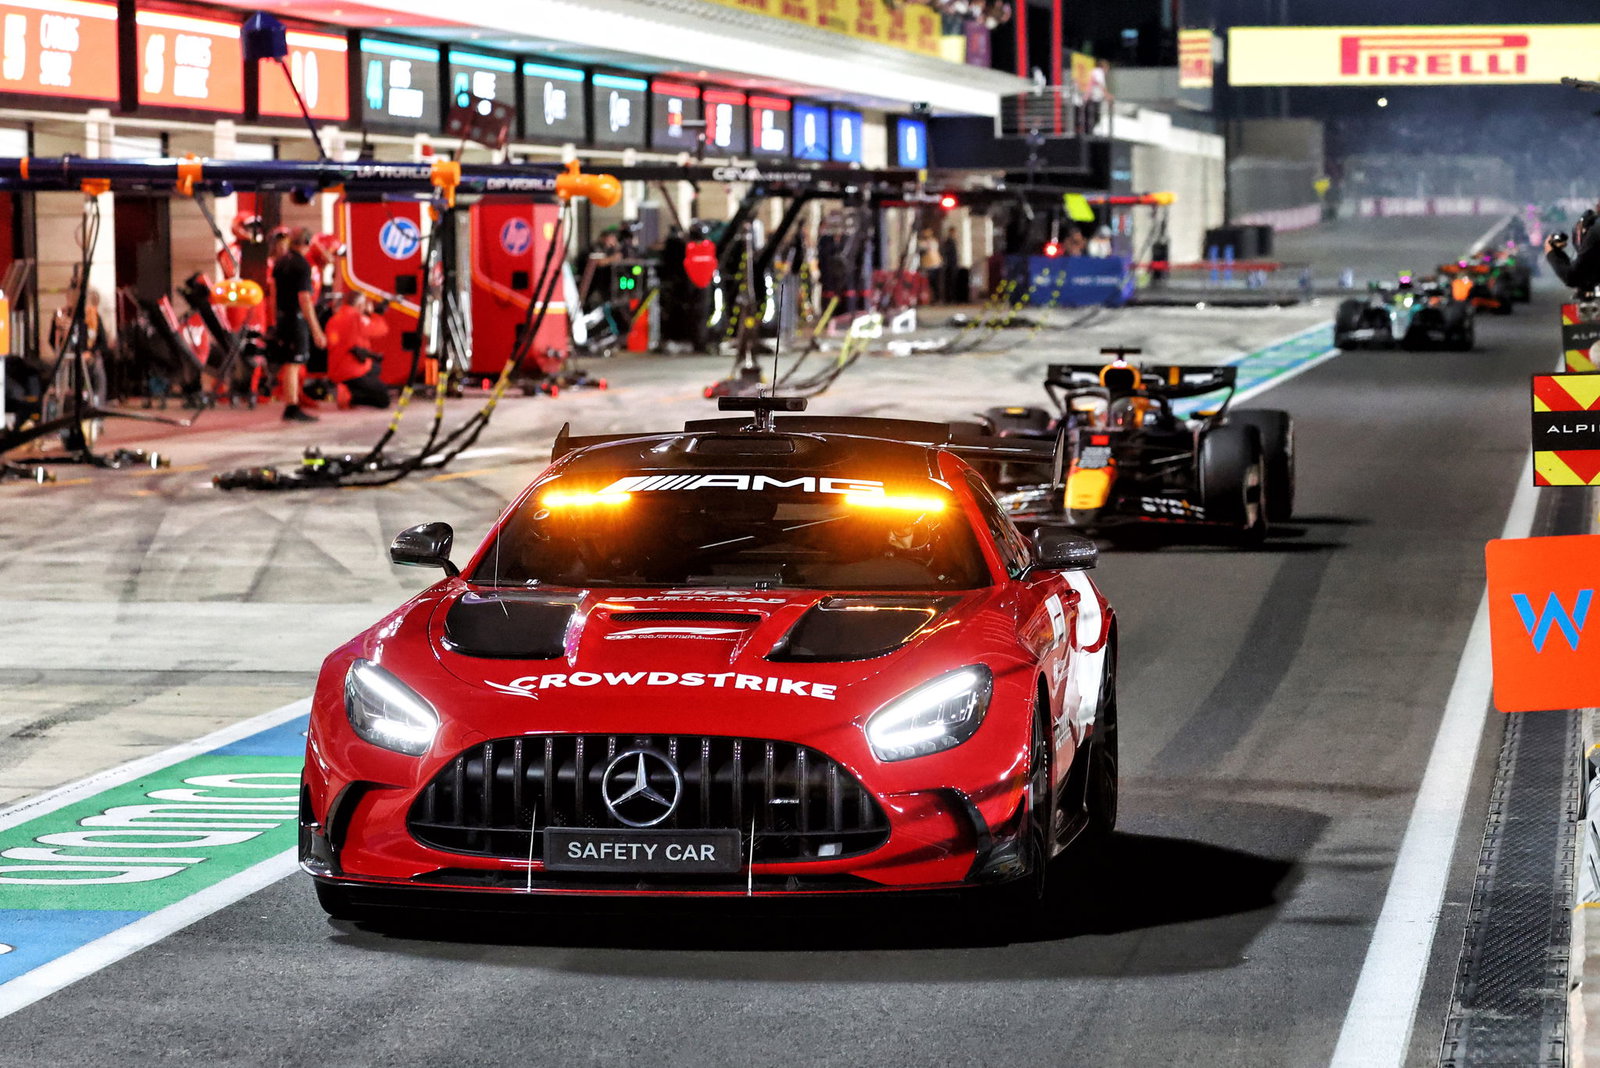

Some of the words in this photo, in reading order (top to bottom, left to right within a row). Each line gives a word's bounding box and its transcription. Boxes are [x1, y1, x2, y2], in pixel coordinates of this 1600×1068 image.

[1340, 34, 1529, 76] PIRELLI
[1572, 331, 1600, 340] ALP
[1546, 424, 1600, 434] ALPI
[1510, 589, 1594, 653] W
[508, 671, 837, 701] CROWDSTRIKE
[567, 841, 659, 861] SAFETY
[665, 844, 716, 861] CAR
